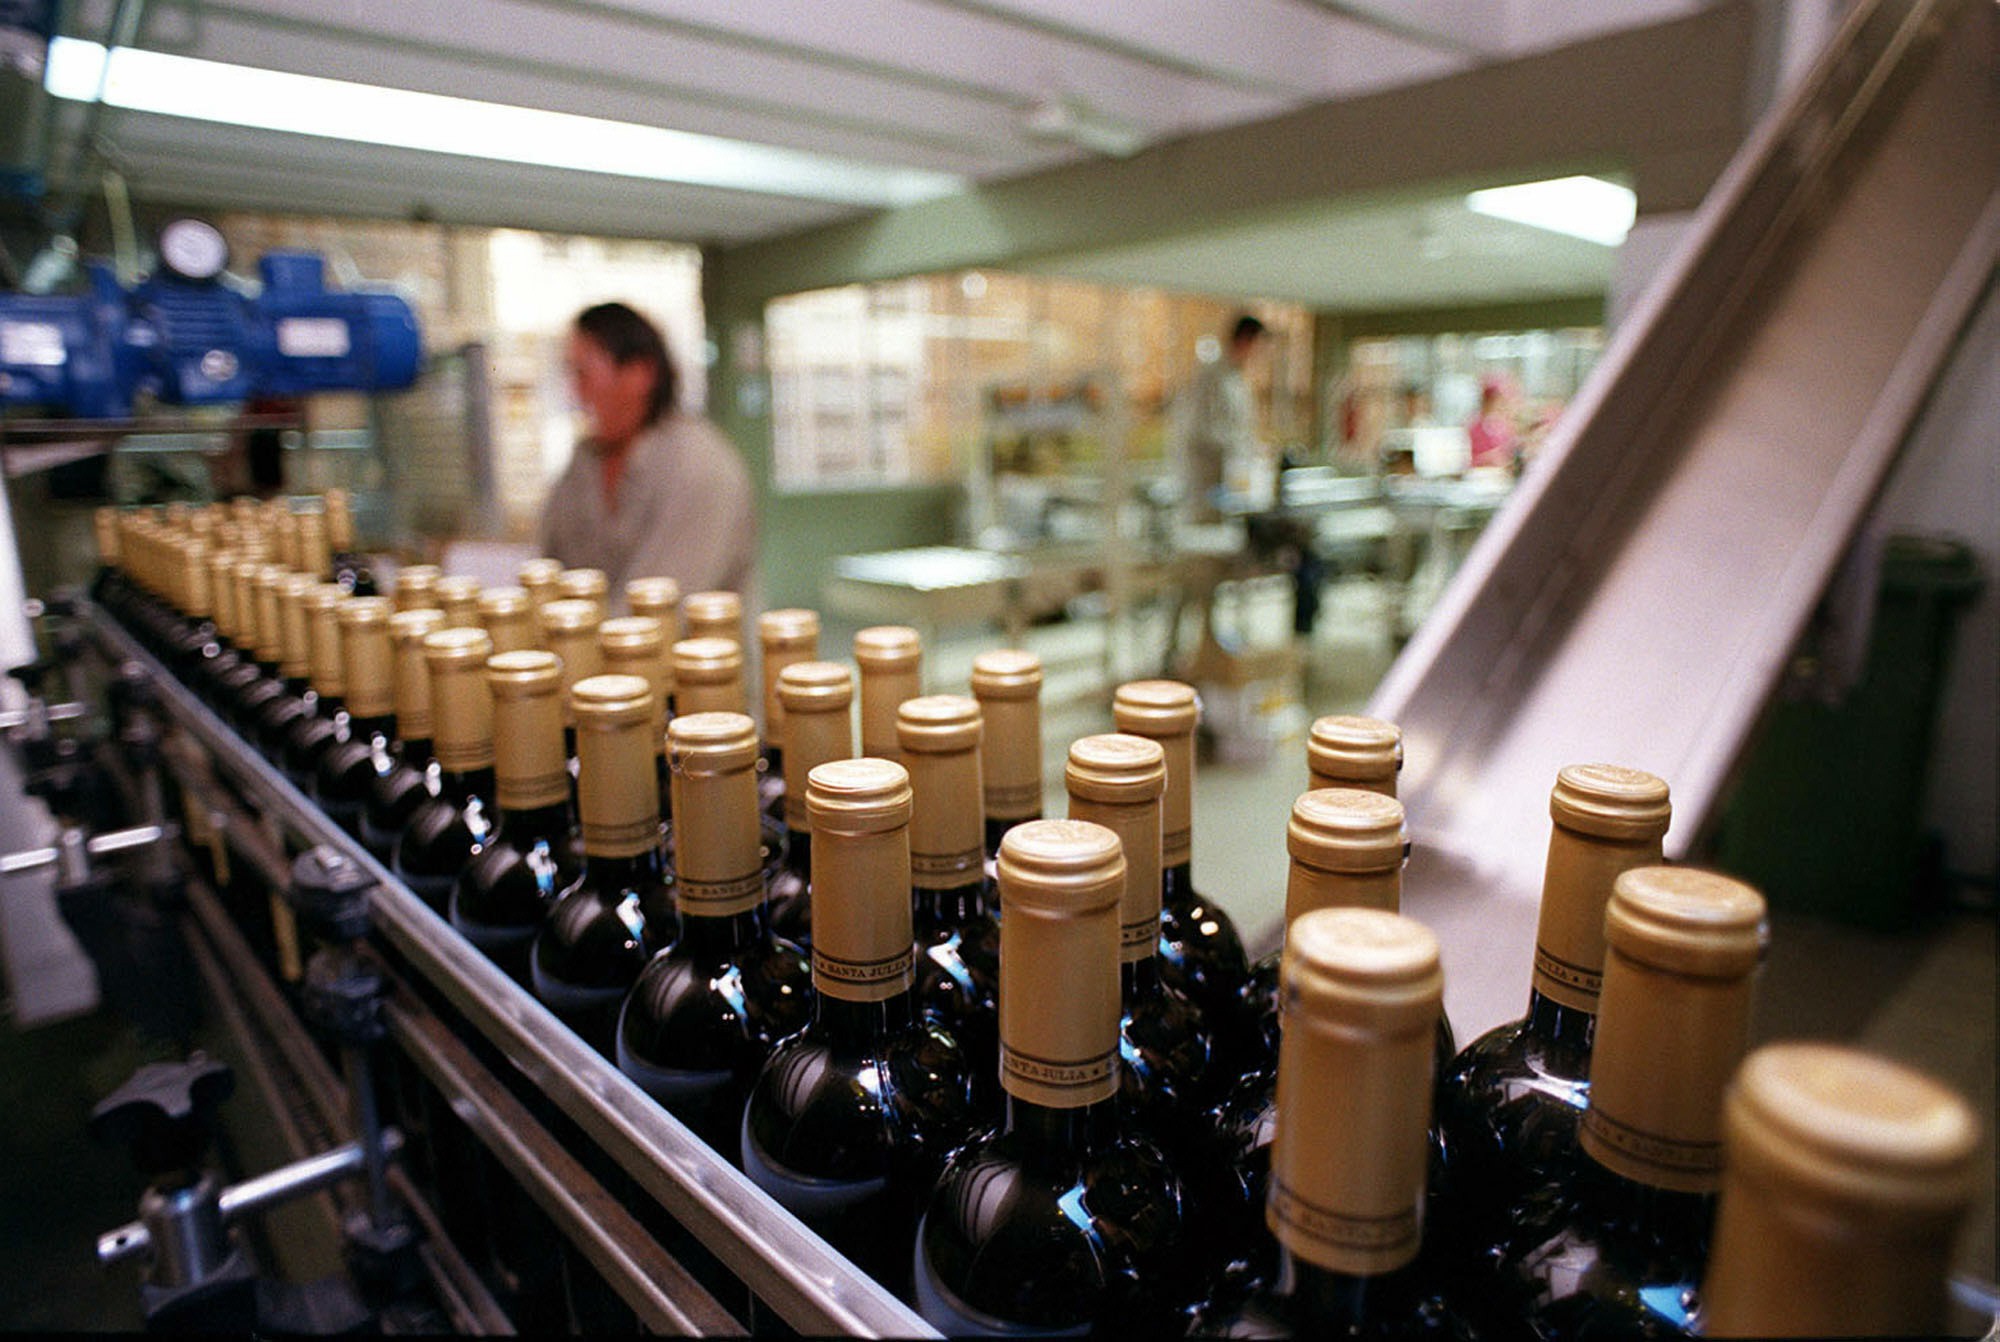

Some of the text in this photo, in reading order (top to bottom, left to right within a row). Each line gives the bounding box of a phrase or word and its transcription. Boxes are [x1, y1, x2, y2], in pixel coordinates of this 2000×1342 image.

[828, 960, 907, 978] SANTA JULIA
[1042, 1067, 1087, 1081] JULIA
